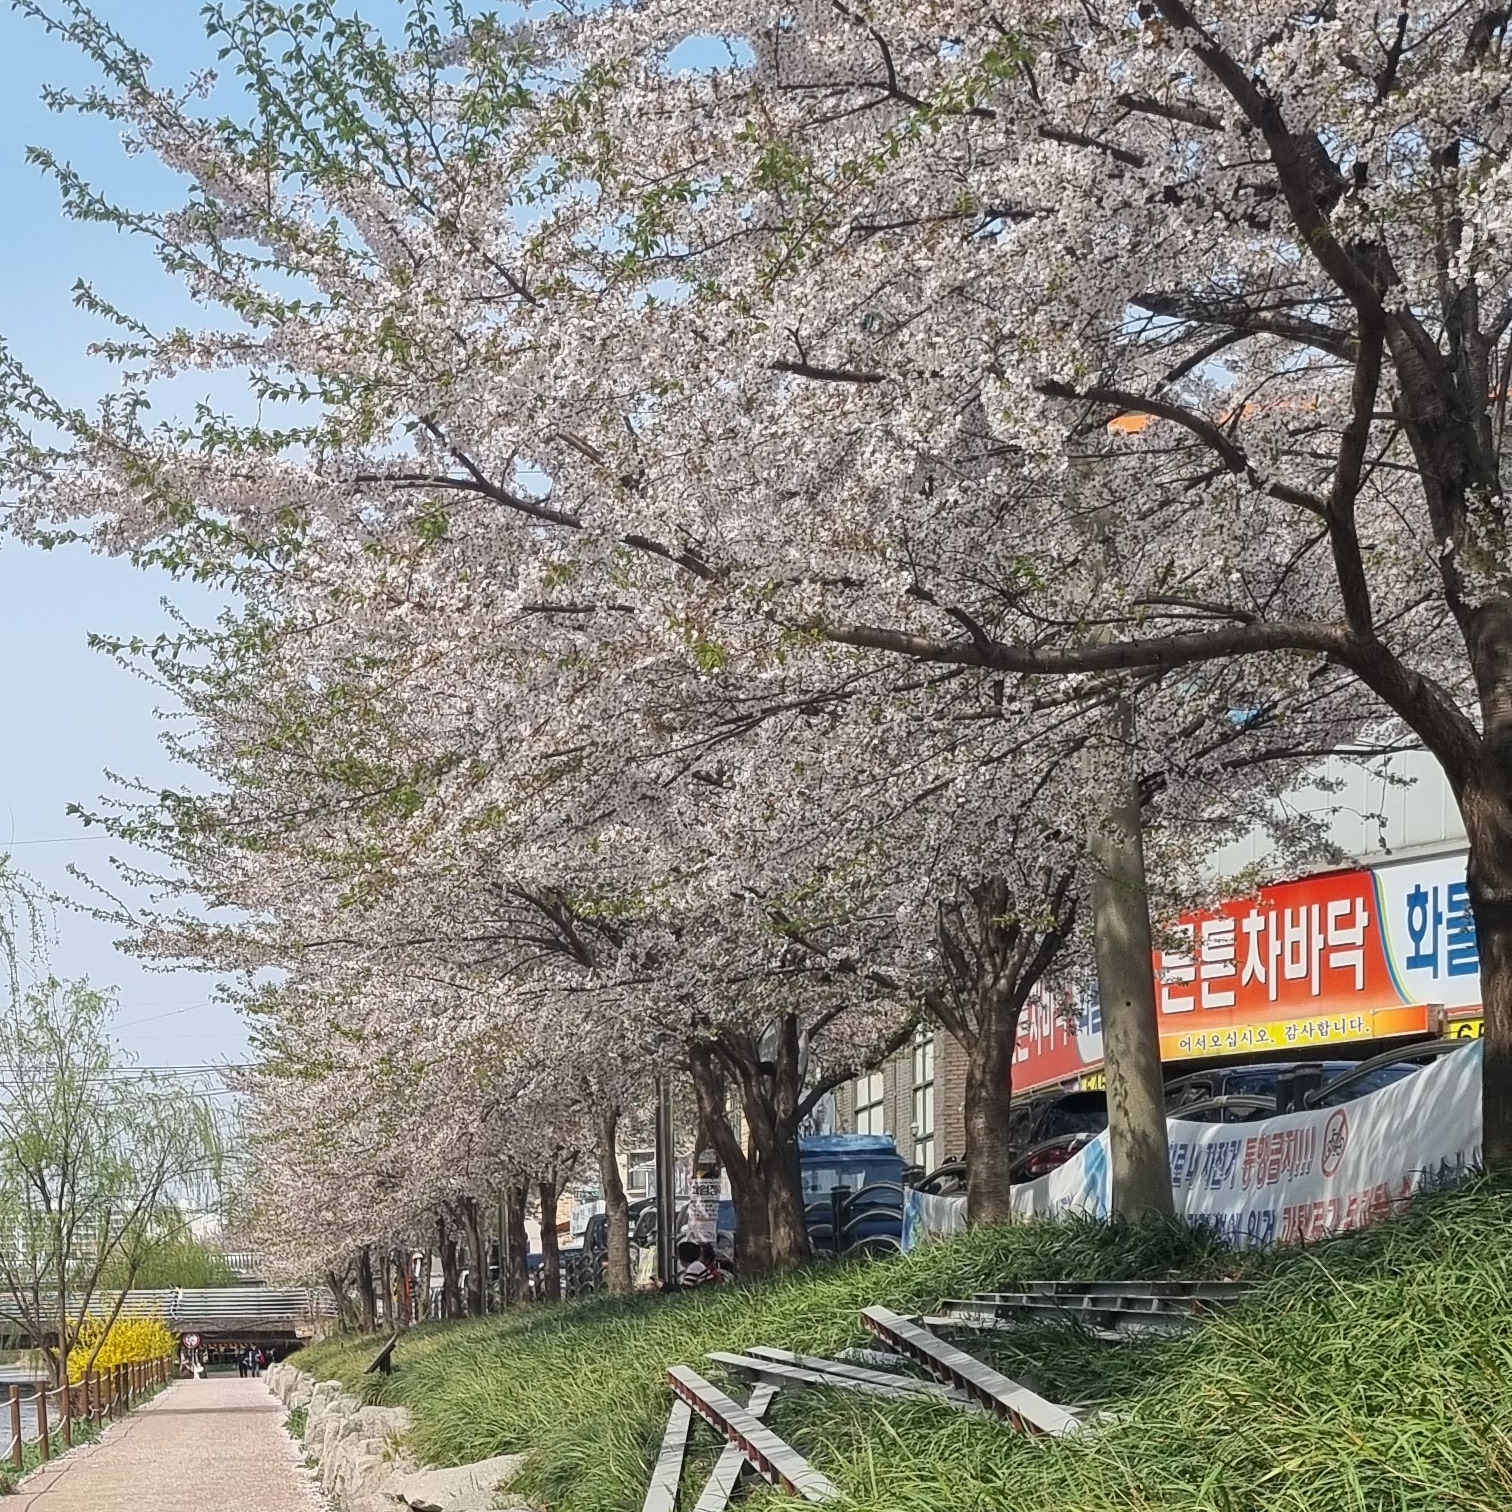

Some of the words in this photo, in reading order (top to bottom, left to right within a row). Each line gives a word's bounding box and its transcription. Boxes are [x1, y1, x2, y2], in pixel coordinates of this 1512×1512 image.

[1160, 896, 1369, 1014] 튼튼차바닥
[1179, 1029, 1275, 1052] 어서오십시오.
[1285, 1016, 1370, 1041] 감사합니다.
[1201, 1139, 1243, 1191] 자전거
